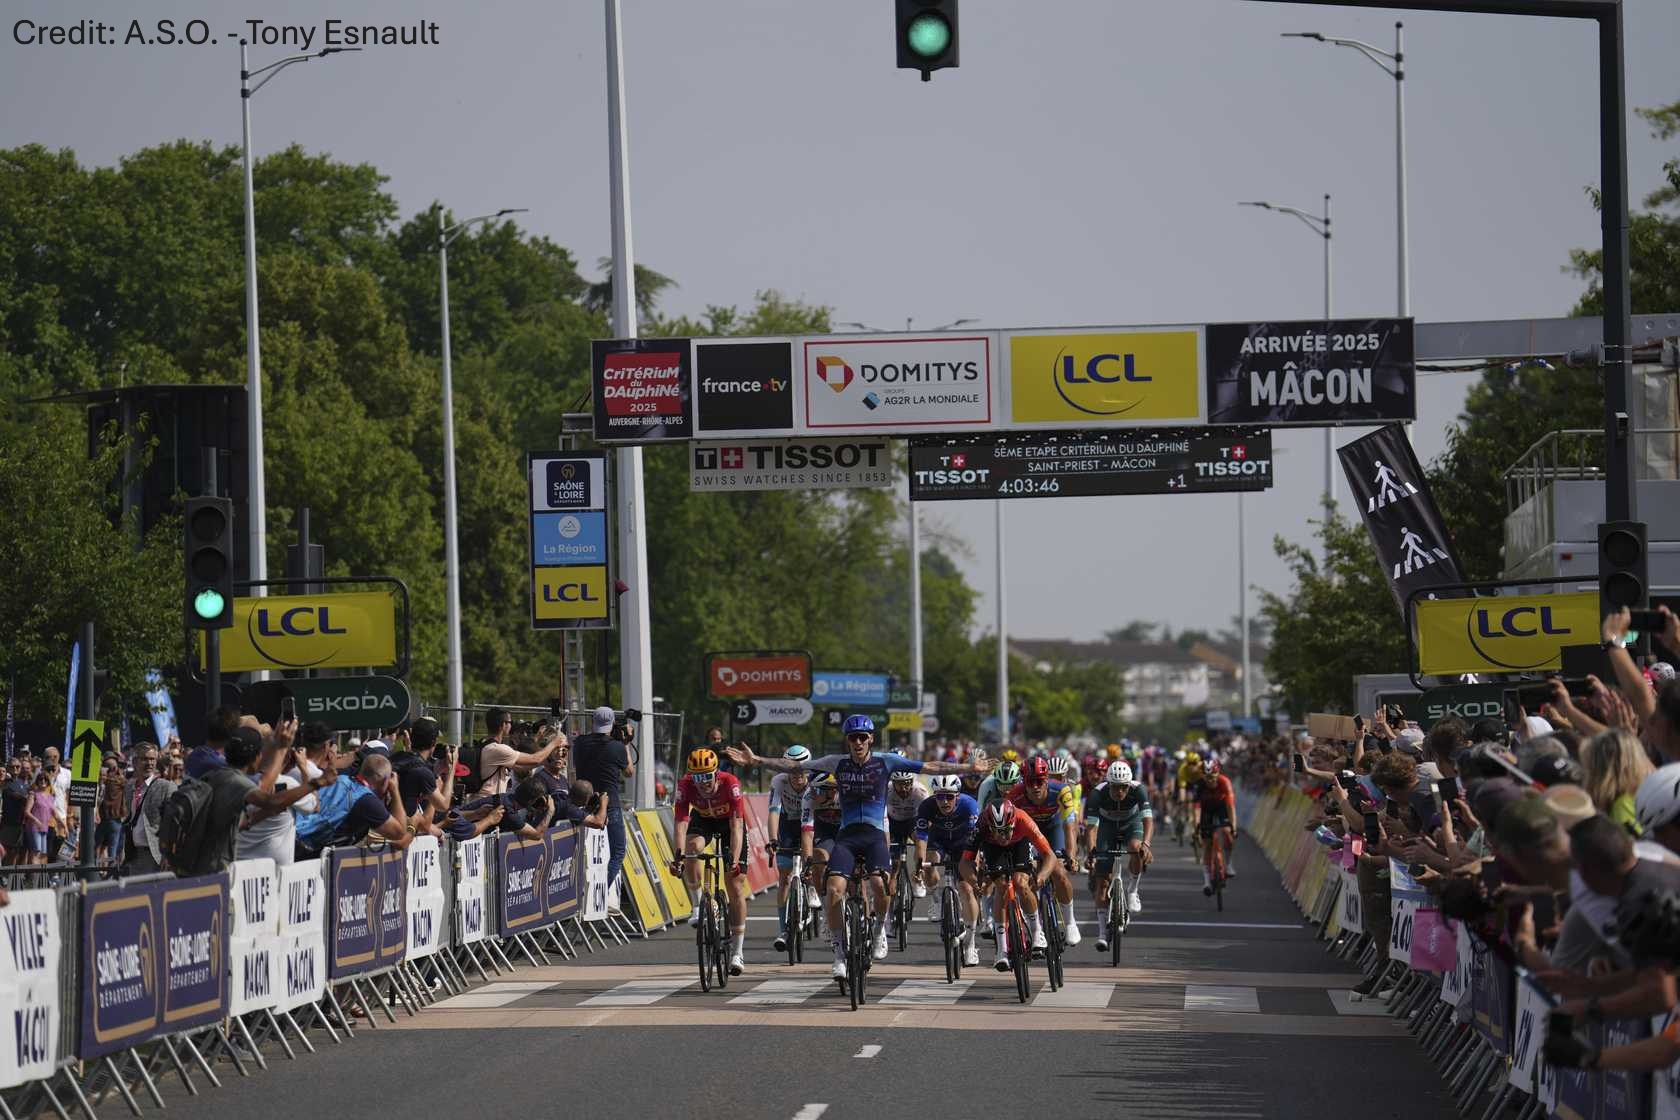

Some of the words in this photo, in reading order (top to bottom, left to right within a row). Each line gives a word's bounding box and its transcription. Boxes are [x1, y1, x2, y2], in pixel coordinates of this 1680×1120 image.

[1240, 330, 1327, 353] ARRIVÉE
[1332, 333, 1379, 351] 2025
[861, 361, 978, 383] DOMITYS
[1063, 353, 1152, 384] LCL
[1250, 361, 1372, 406] MÂCON
[884, 396, 911, 405] AG2R
[913, 395, 926, 404] LA
[928, 394, 979, 404] MONDIALE
[630, 403, 657, 412] 2025
[1025, 446, 1057, 456] ETAPE
[1119, 443, 1134, 454] DU
[1137, 440, 1189, 454] DAUPHINÉ
[748, 443, 886, 469] TISSOT
[1028, 460, 1100, 472] SAINT-PRIEST
[1195, 461, 1270, 476] TISSOT
[695, 476, 736, 486] SWISS
[744, 474, 805, 485] WATCHES
[812, 473, 851, 484] SINCE
[859, 472, 887, 482] 1853
[915, 469, 990, 484] TISSOT
[1168, 474, 1187, 488] +1
[553, 480, 585, 490] SAÔNE
[998, 477, 1060, 493] 4:03:46
[559, 491, 585, 499] LOIRE
[543, 544, 556, 554] La
[559, 543, 596, 555] Région
[543, 583, 599, 602] LCL
[257, 607, 346, 637] LCL
[1477, 606, 1571, 638] LCL
[741, 670, 801, 682] DOMITYS
[737, 704, 749, 718] 25
[1428, 702, 1504, 719] SKOD
